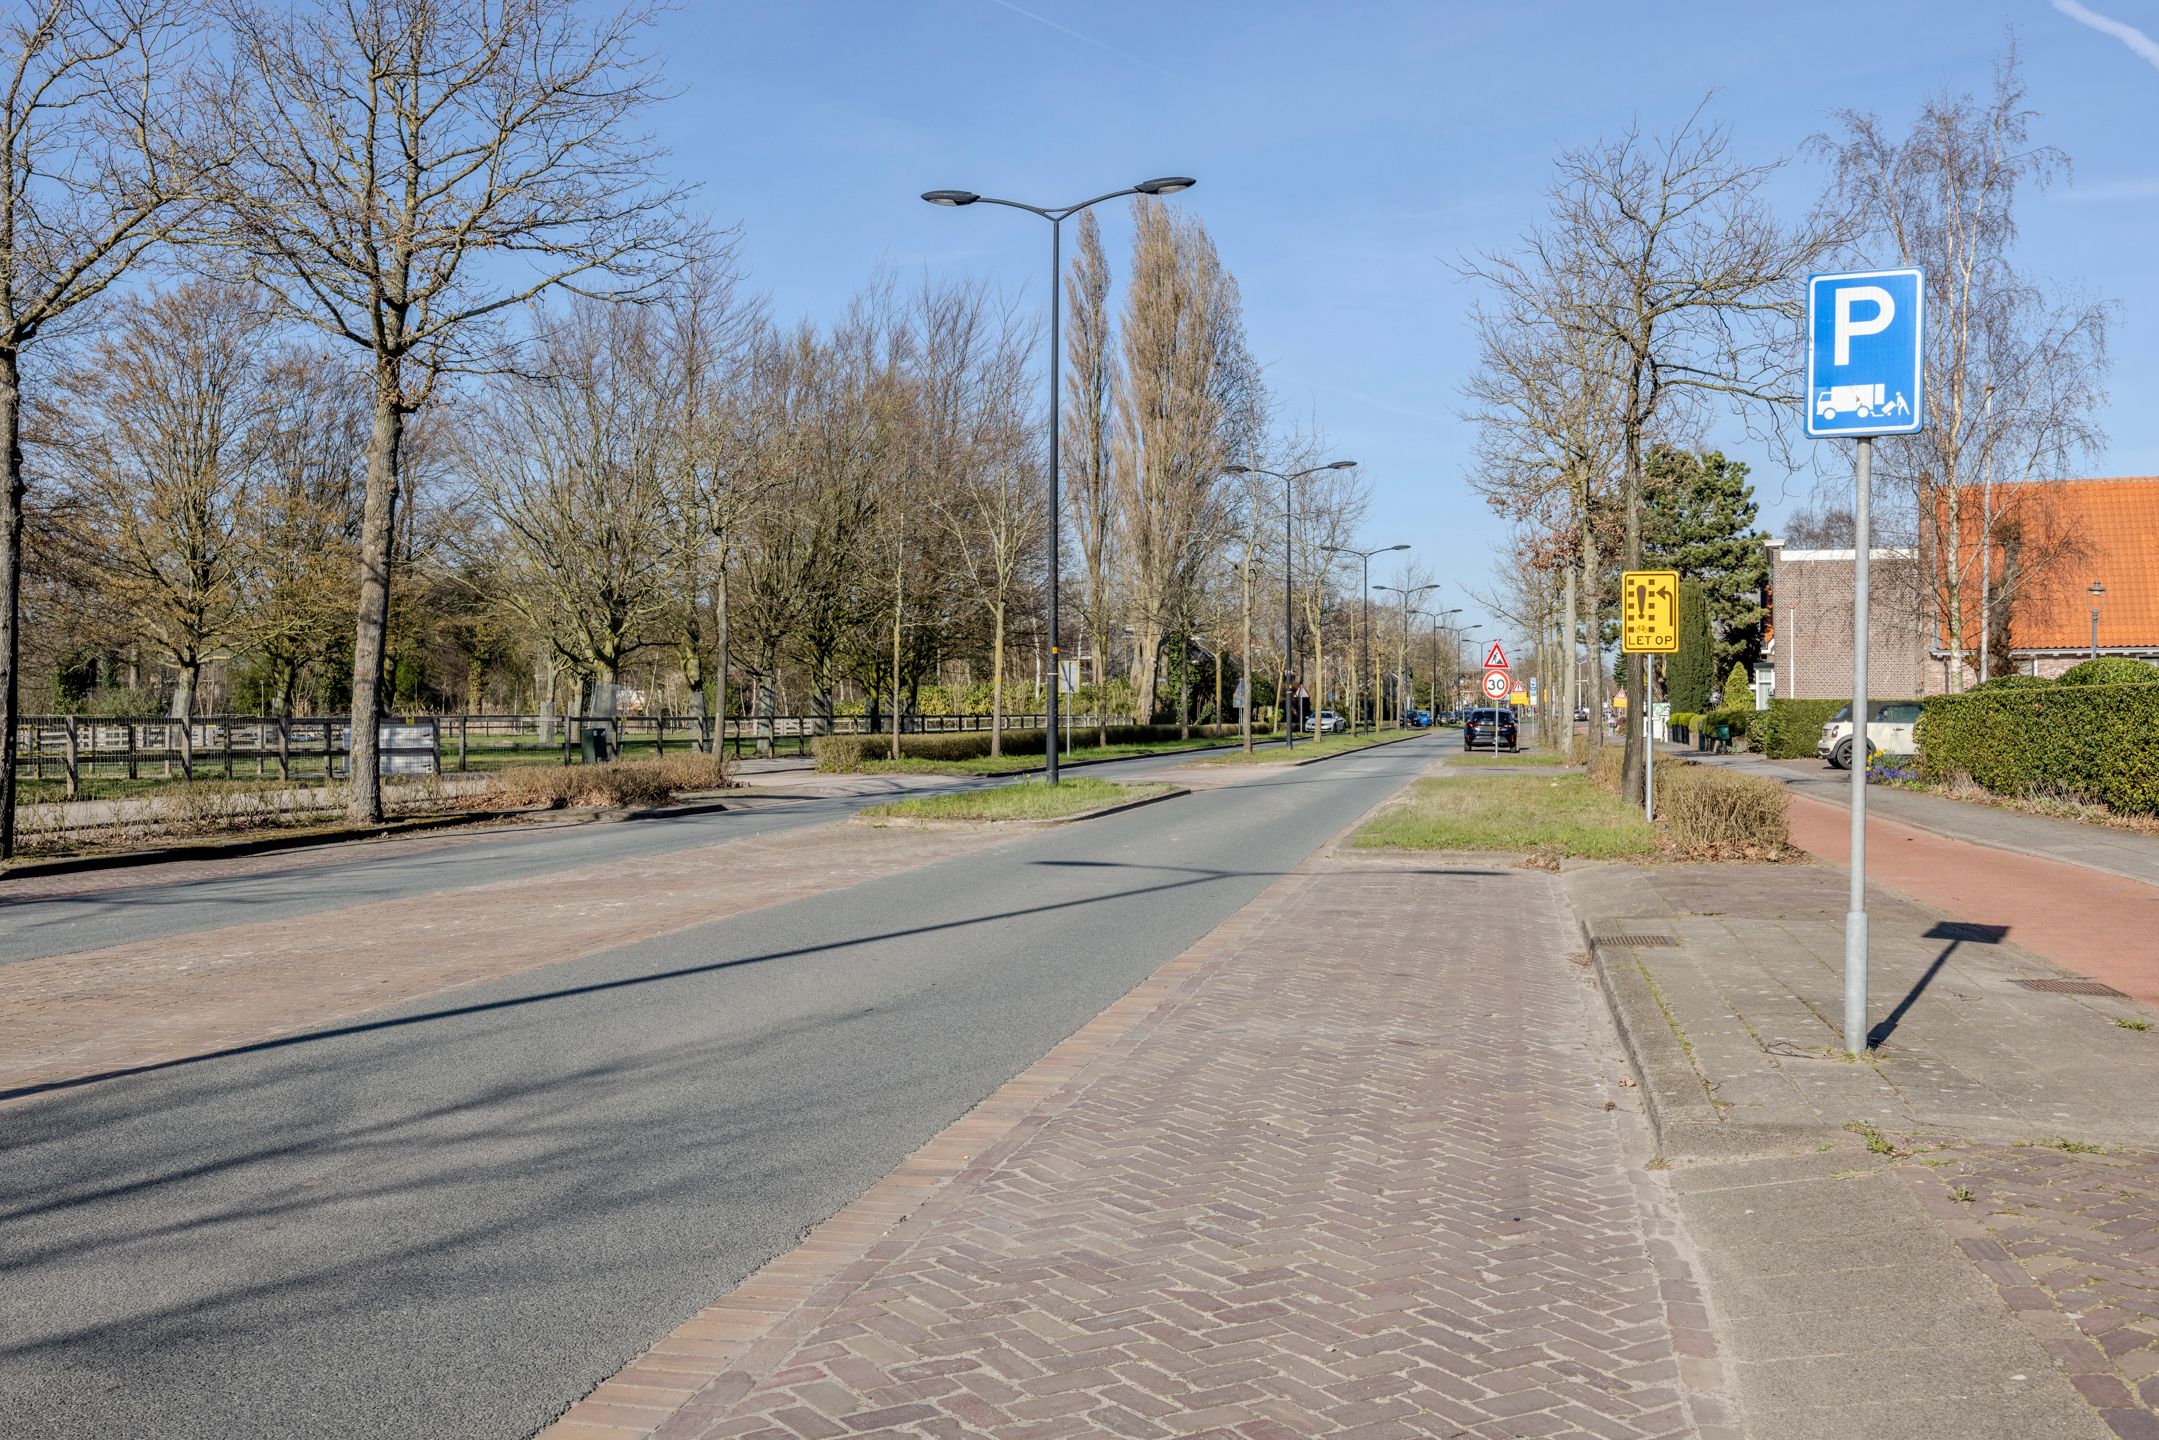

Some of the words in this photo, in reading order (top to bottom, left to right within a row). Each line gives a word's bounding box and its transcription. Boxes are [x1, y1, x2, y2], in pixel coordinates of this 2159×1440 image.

[1834, 285, 1896, 367] P
[1628, 635, 1652, 646] LET
[1655, 635, 1673, 646] OP
[1487, 679, 1505, 691] 30
